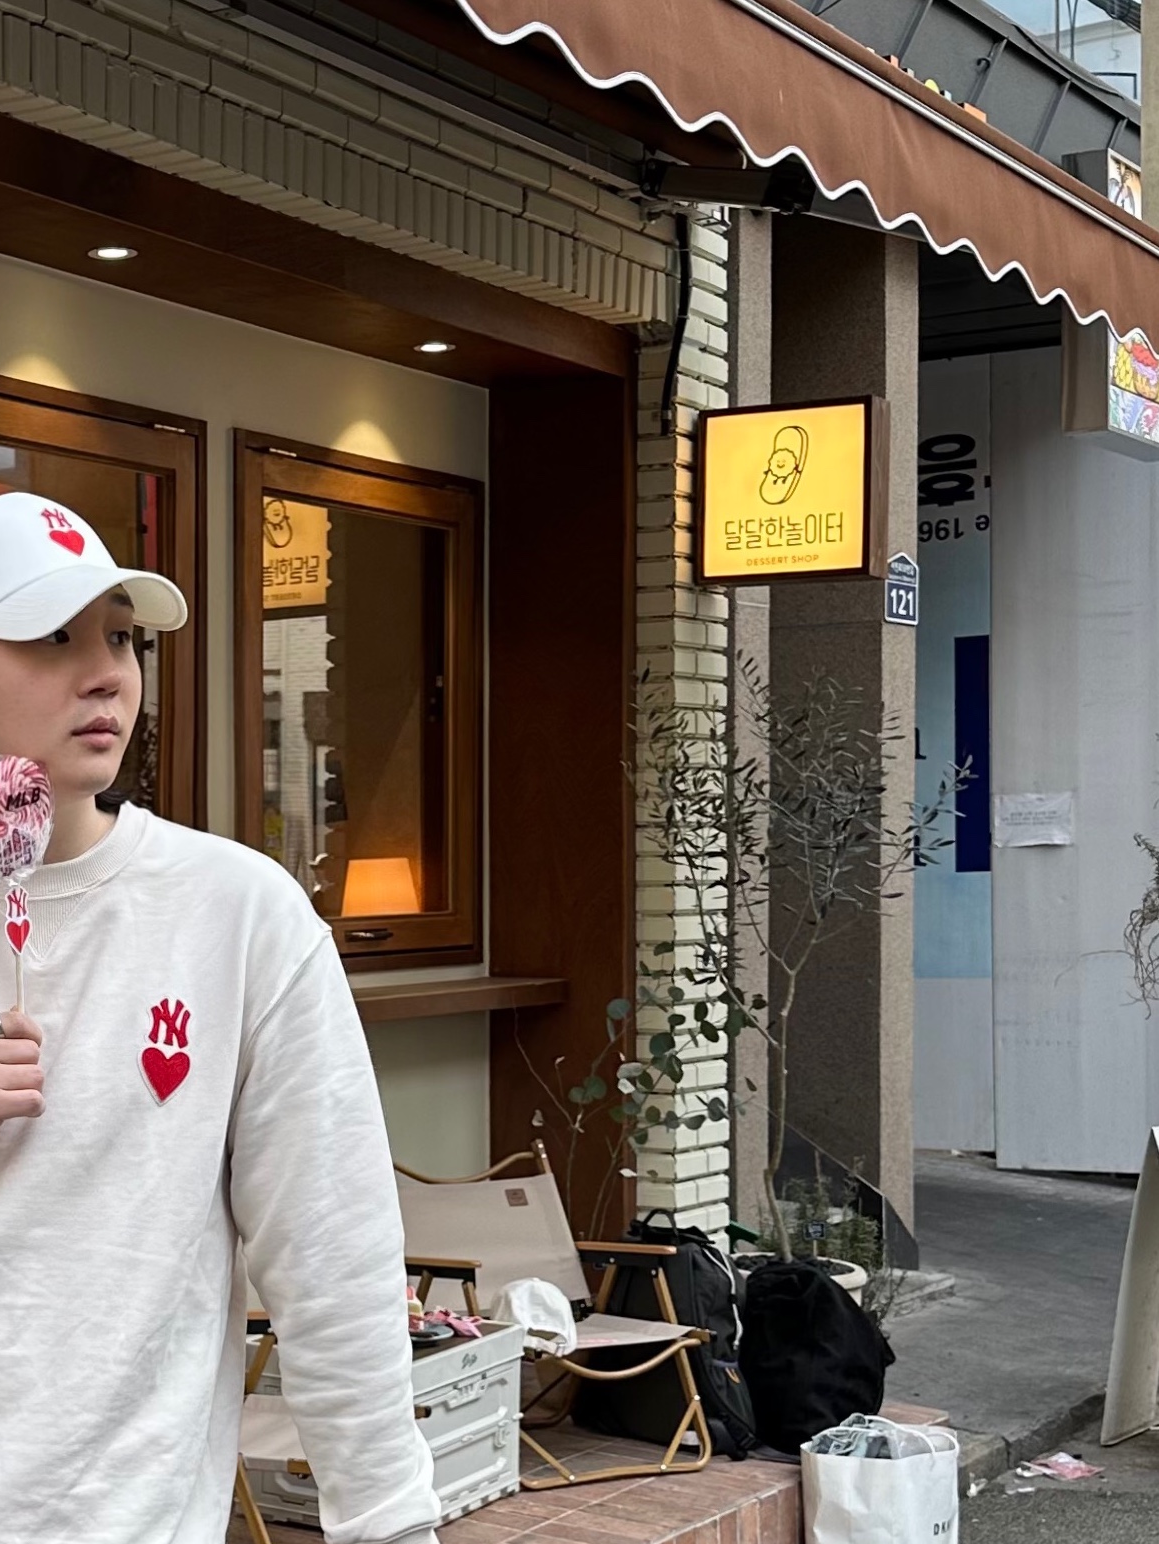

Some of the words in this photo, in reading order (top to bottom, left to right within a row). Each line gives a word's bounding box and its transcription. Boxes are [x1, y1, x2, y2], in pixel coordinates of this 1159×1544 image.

[41, 508, 72, 529] NY
[725, 511, 843, 551] 달달한놀이터
[746, 556, 788, 566] DESSERT
[791, 554, 819, 564] SHOP
[890, 588, 914, 617] 121
[5, 786, 41, 811] MLB
[148, 998, 191, 1049] NY
